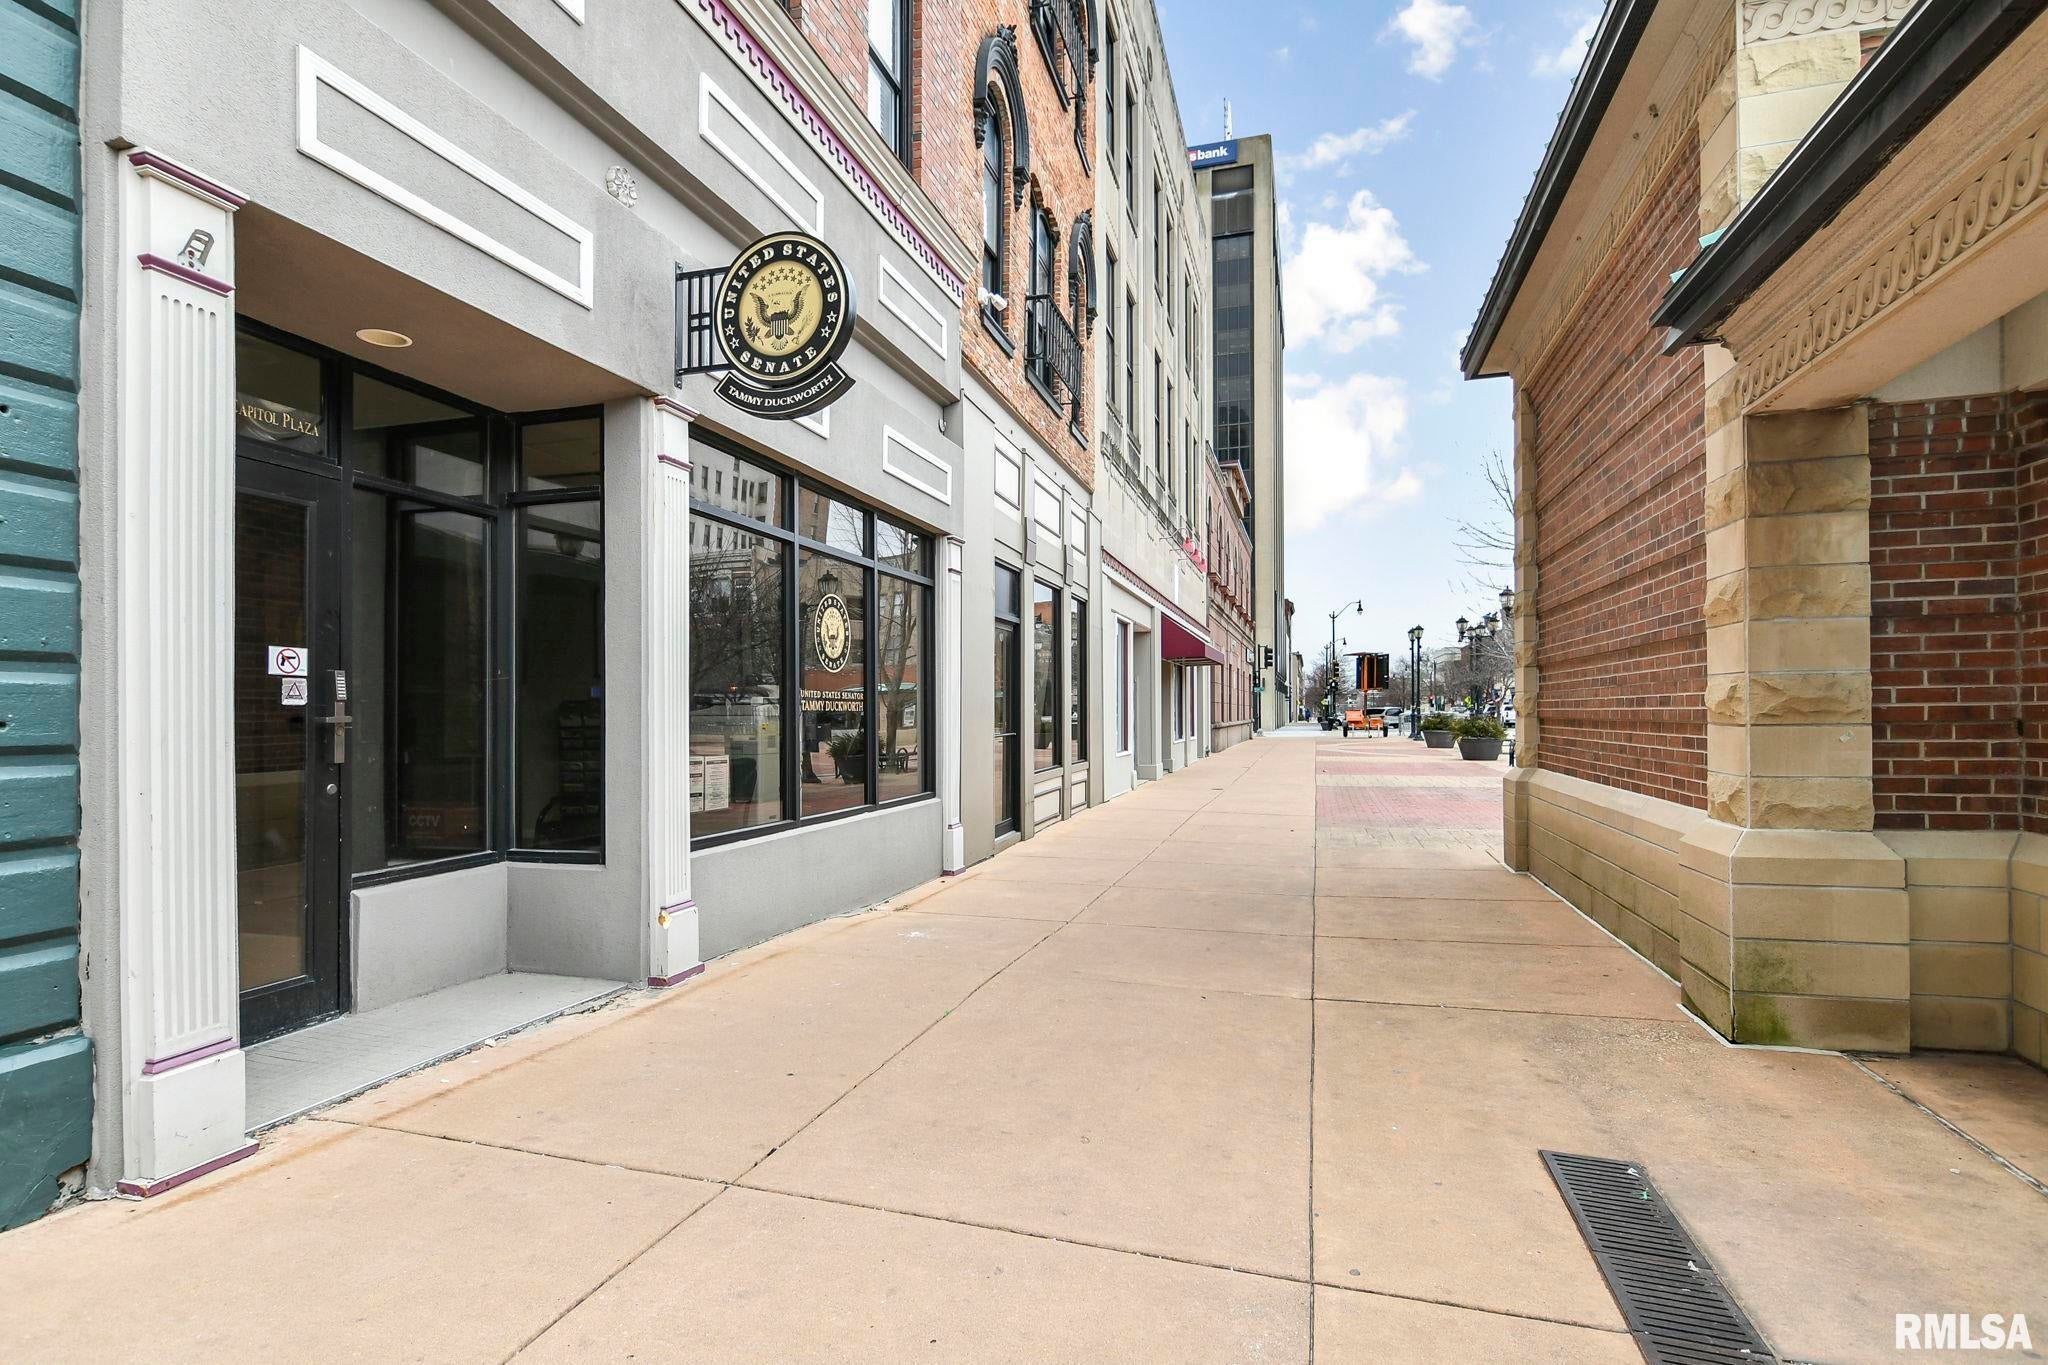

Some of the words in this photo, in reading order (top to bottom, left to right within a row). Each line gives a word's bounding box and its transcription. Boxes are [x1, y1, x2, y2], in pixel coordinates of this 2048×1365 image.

[724, 247, 775, 320] UNITED
[782, 243, 839, 303] STATES
[739, 346, 817, 373] SENATE
[728, 385, 763, 406] TAMMY
[765, 374, 834, 407] DUCKWORTH
[236, 400, 279, 426] APITOL
[283, 412, 319, 437] PLAZA
[816, 598, 832, 633] UNITED
[833, 599, 849, 636] STATES
[821, 653, 844, 669] SENATE
[800, 690, 822, 699] UNITED
[822, 691, 841, 699] STATES
[842, 692, 864, 700] SENATOR
[800, 699, 825, 711] TAMMY
[825, 700, 864, 712] DUCKWORTH
[408, 814, 440, 827] CCTV
